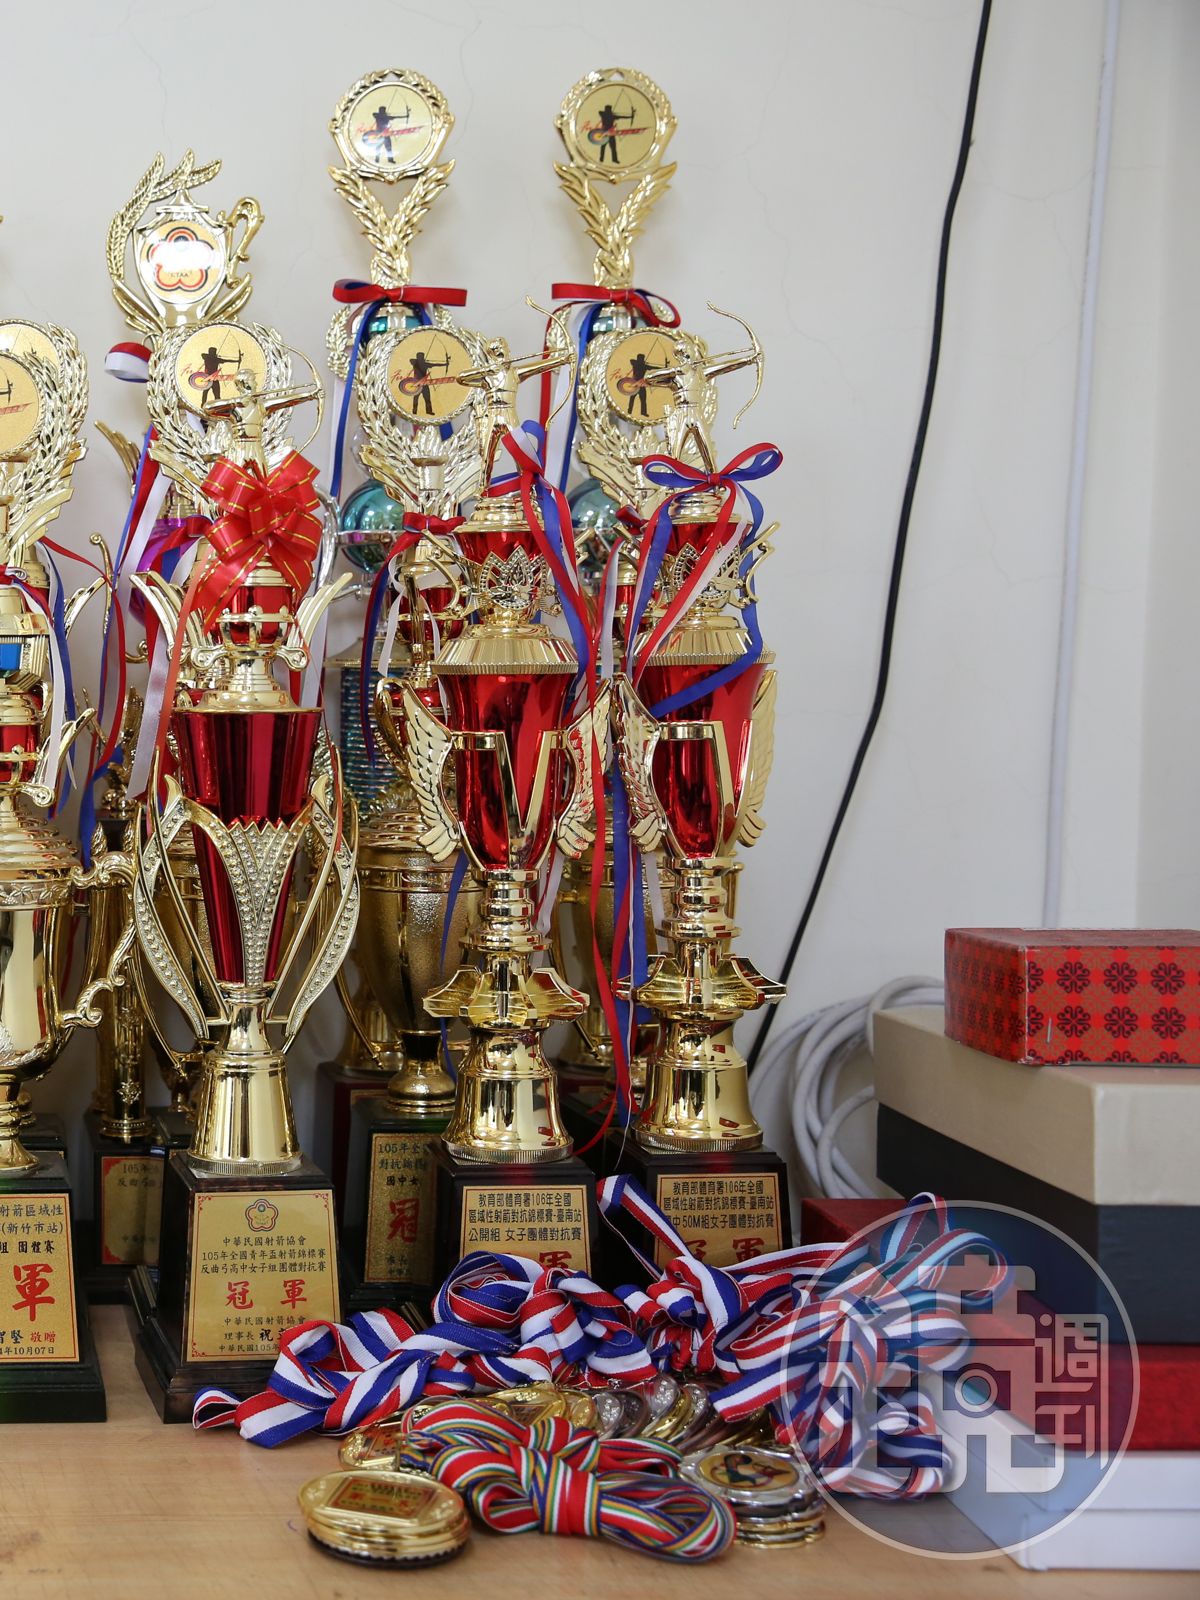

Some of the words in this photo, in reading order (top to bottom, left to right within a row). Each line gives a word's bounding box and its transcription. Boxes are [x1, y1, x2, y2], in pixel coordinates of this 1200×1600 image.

[673, 1180, 764, 1195] 教育部體育署106年全國
[479, 1192, 572, 1208] 教育部體育署106年全國
[223, 1235, 307, 1247] 中華民國射箭協會
[469, 1227, 501, 1242] 公開組
[505, 1227, 582, 1241] 女子團體對抗賽
[18, 1240, 55, 1254] 團體賽
[201, 1261, 327, 1274] 反曲弓高中女子組團體對抗賽
[224, 1330, 255, 1341] 理事長
